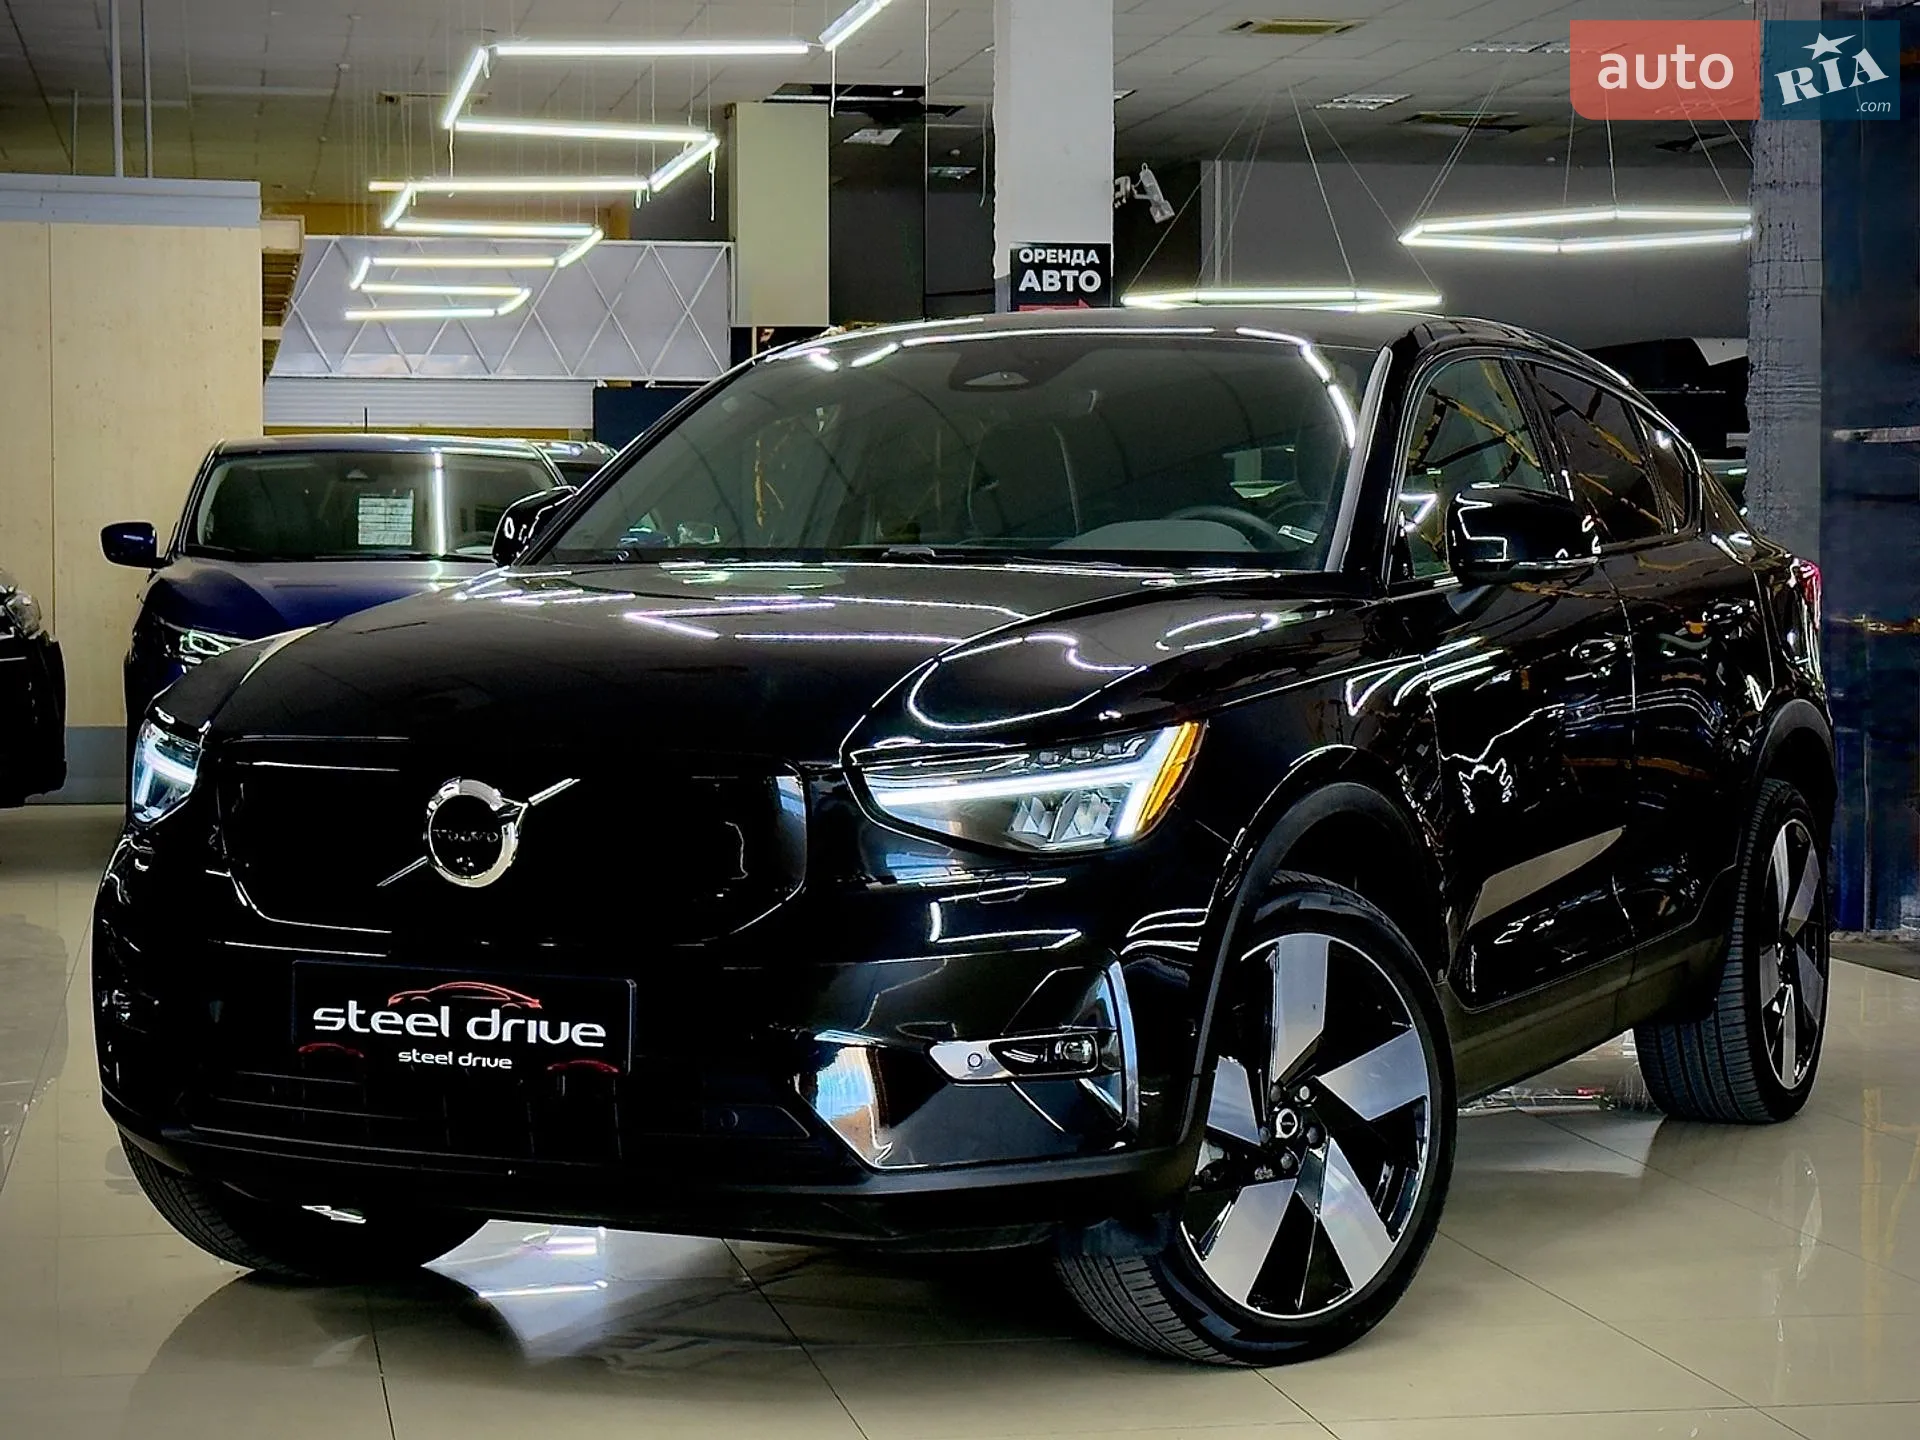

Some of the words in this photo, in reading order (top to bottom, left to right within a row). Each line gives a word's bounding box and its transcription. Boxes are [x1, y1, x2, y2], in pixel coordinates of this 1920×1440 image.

[1018, 247, 1100, 267] ОРЕНДА
[1018, 269, 1102, 293] АВТО
[312, 999, 451, 1039] steel
[465, 1008, 607, 1048] drive
[398, 1048, 454, 1066] steel
[457, 1052, 513, 1070] drive
